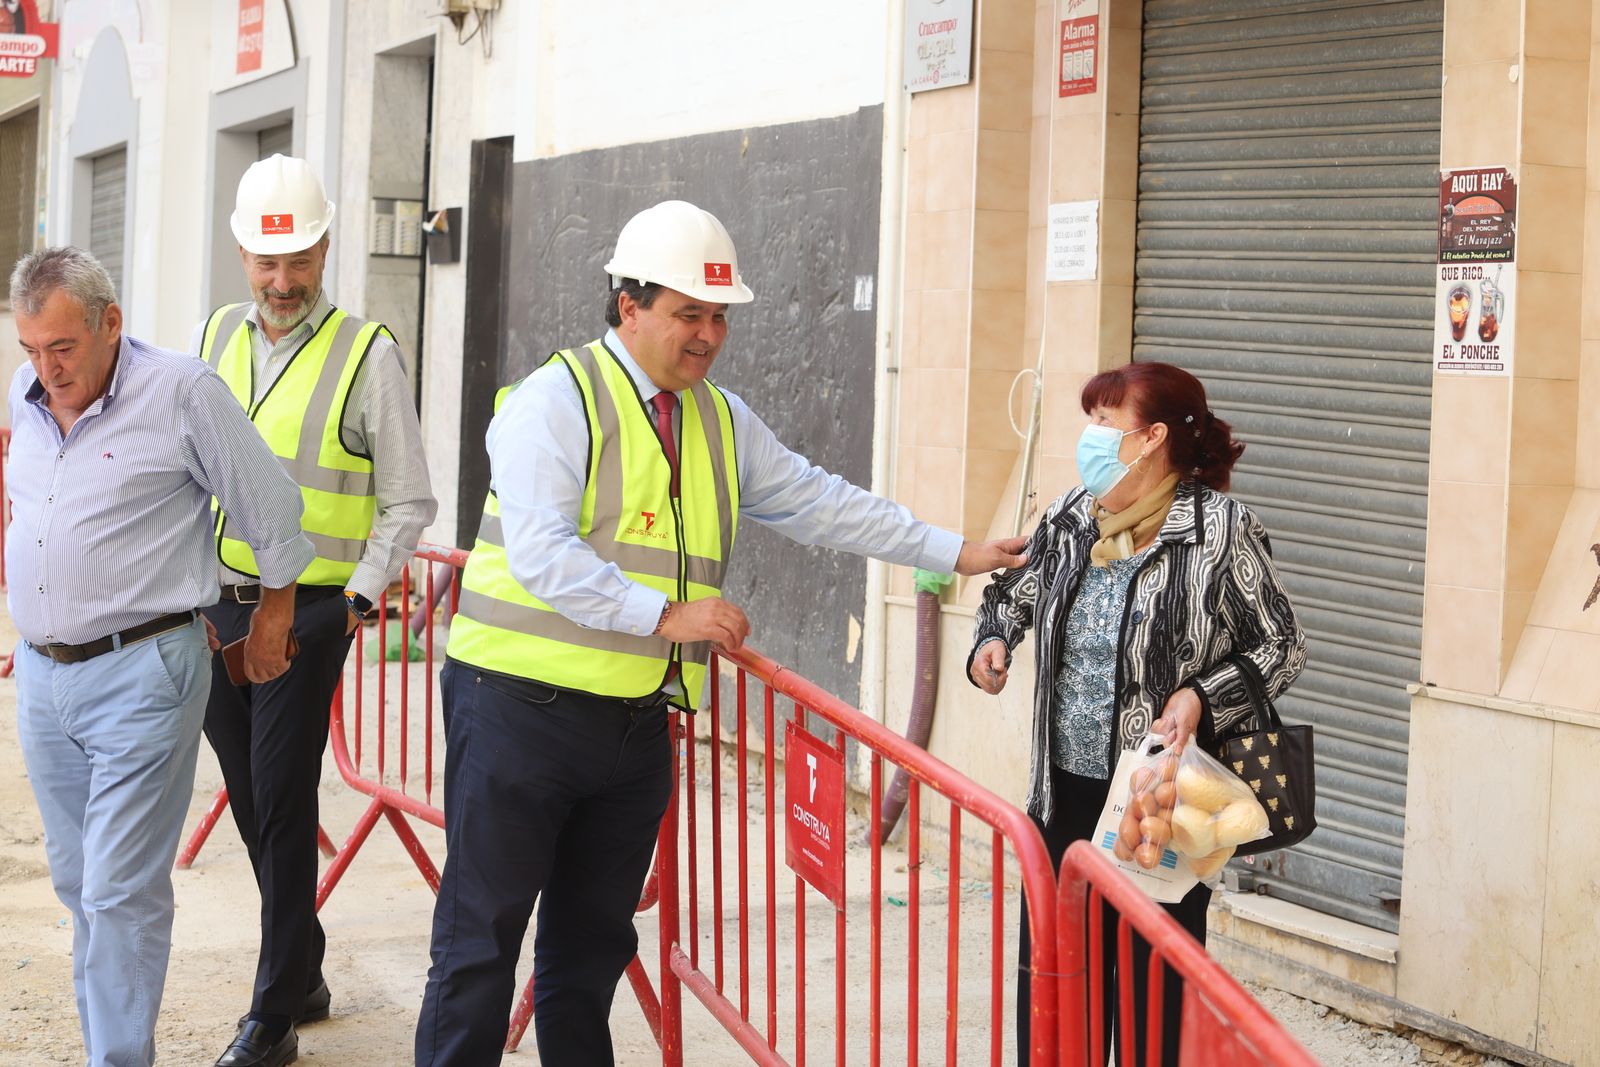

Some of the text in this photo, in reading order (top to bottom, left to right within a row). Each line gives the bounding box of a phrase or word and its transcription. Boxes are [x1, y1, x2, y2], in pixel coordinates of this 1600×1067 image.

[918, 18, 957, 36] Cruzcampo
[1064, 24, 1095, 41] Alarma
[0, 42, 38, 53] ampo
[1451, 173, 1504, 193] AQUI HAY
[1442, 267, 1490, 280] QUE RICO...
[1443, 345, 1500, 360] EL PONCHE
[793, 803, 830, 843] CONSTRUYA
